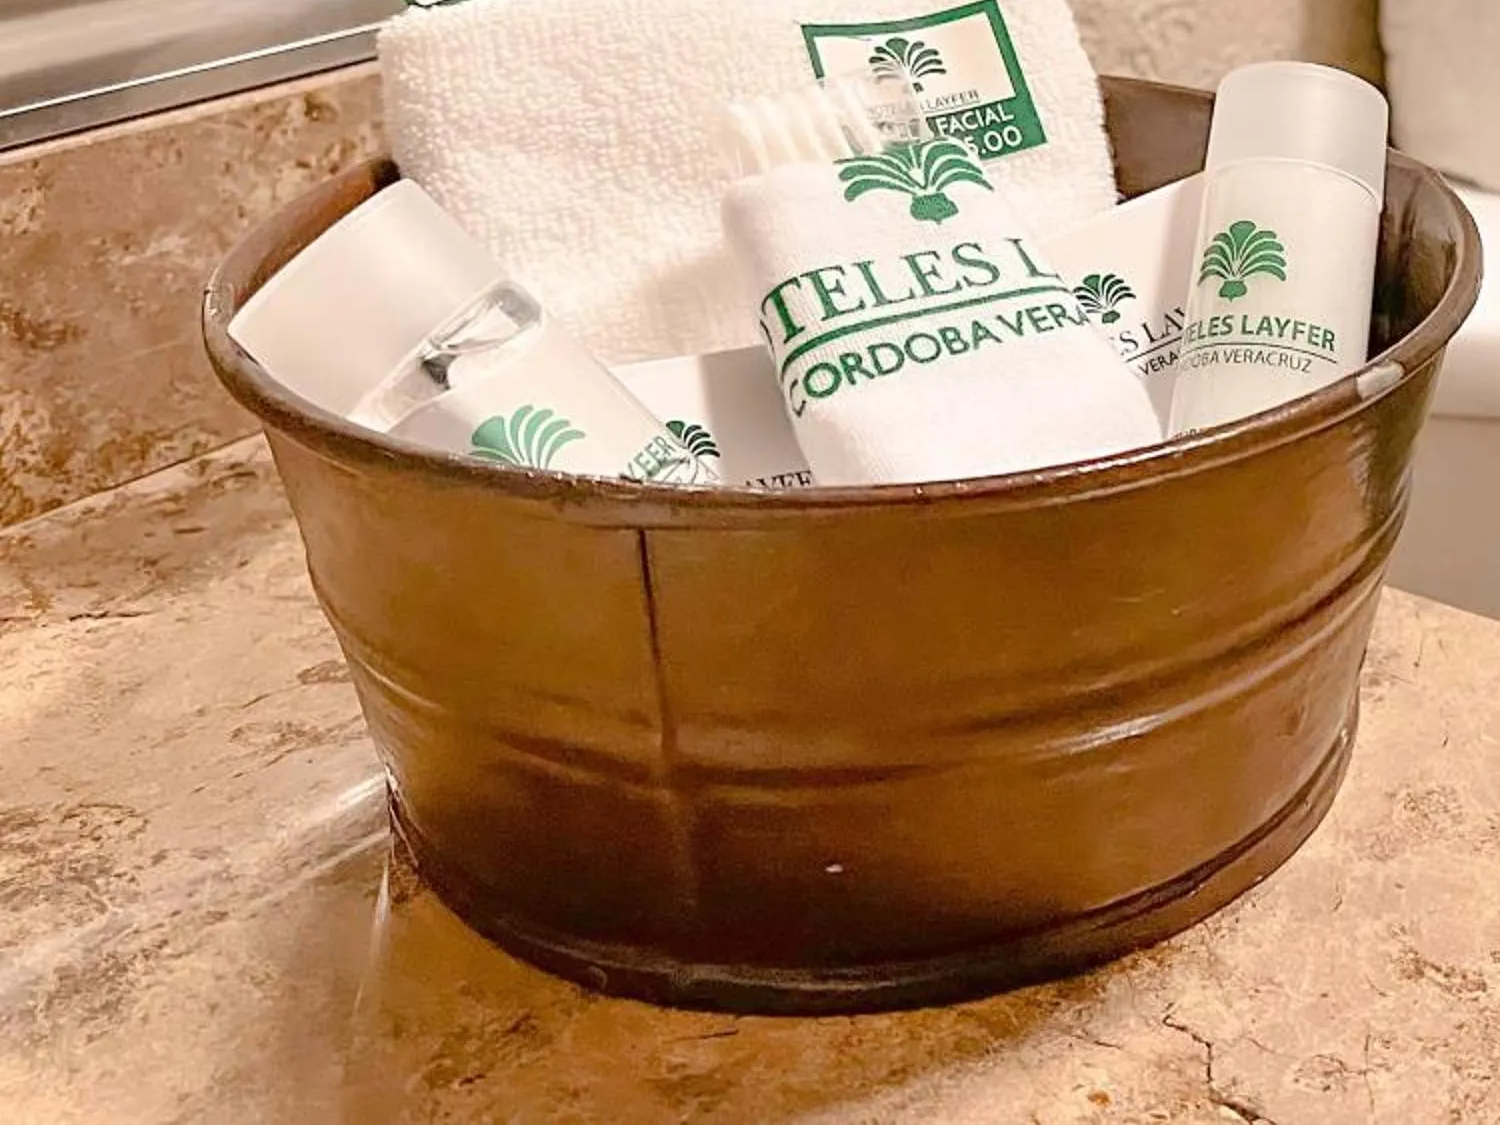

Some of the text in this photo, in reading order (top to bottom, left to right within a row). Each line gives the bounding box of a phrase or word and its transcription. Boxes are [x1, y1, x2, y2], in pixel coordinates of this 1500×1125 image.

[935, 105, 1014, 136] FACIAL
[760, 242, 1000, 346] TELES
[1241, 314, 1336, 353] LAYFER
[1138, 349, 1181, 376] VERA
[1223, 348, 1313, 374] VERACRUZ
